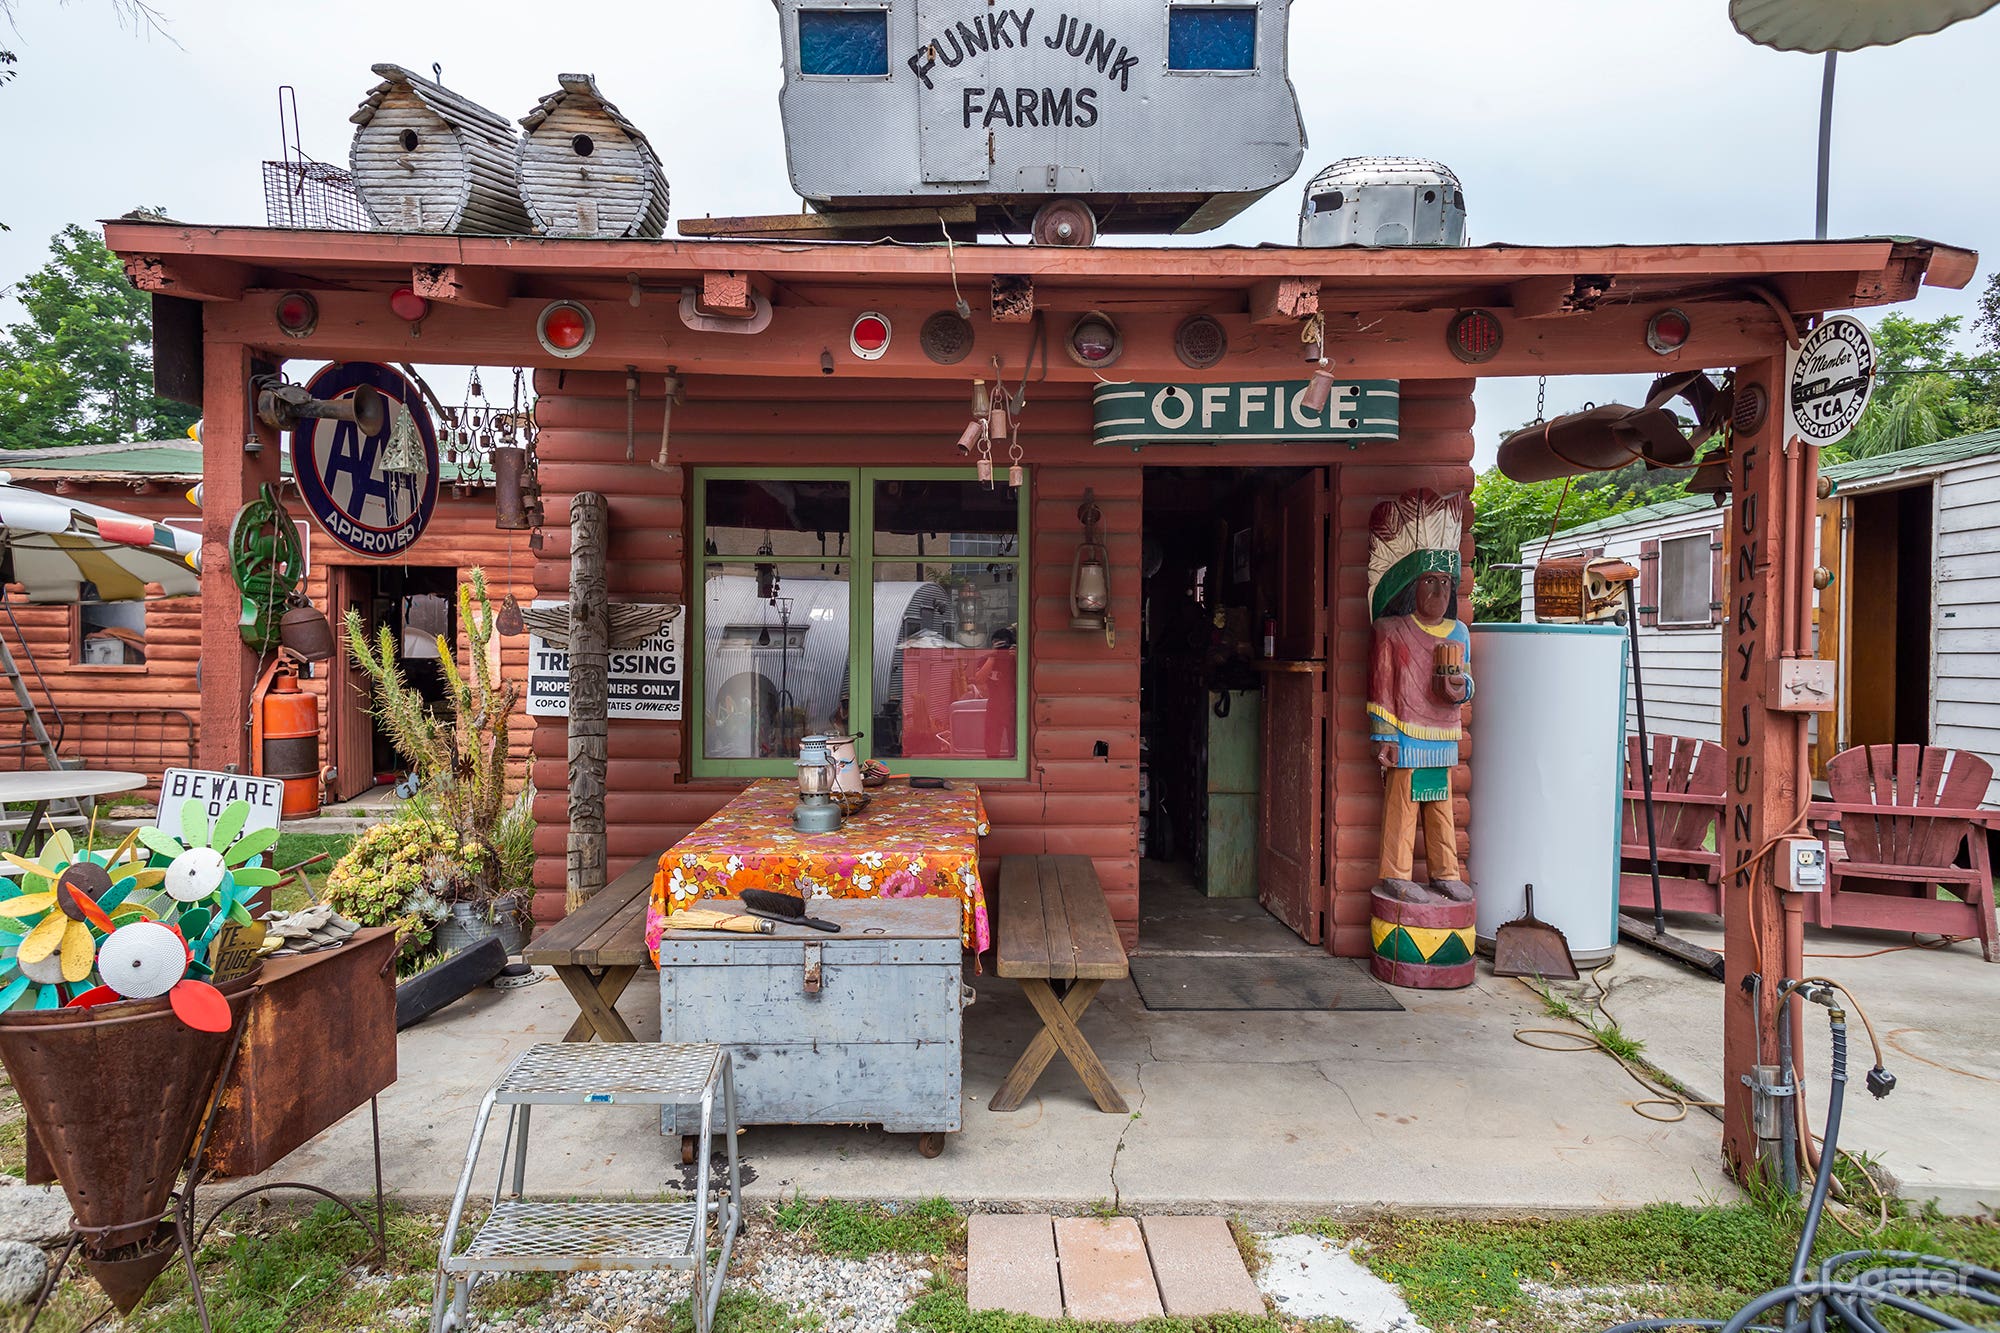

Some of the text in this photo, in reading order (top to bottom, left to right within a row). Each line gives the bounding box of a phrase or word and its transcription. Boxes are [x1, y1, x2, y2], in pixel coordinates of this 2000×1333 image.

[907, 8, 1139, 92] FUNKY JUNK
[963, 87, 1098, 128] FARMS
[1793, 322, 1870, 384] TRAILER COACH
[1809, 346, 1852, 375] Member
[1151, 386, 1361, 429] OFFICE
[1795, 394, 1863, 437] ASSOCIATION
[1812, 398, 1843, 420] TCA
[325, 510, 415, 552] APPROVED
[537, 652, 676, 675] TRESSING
[1735, 447, 1758, 888] FUNKY JUNK
[535, 699, 680, 712] COPCO TATES OWNERS
[607, 683, 638, 694] NERS
[641, 684, 675, 696] ONLY
[172, 775, 275, 806] BEWARE
